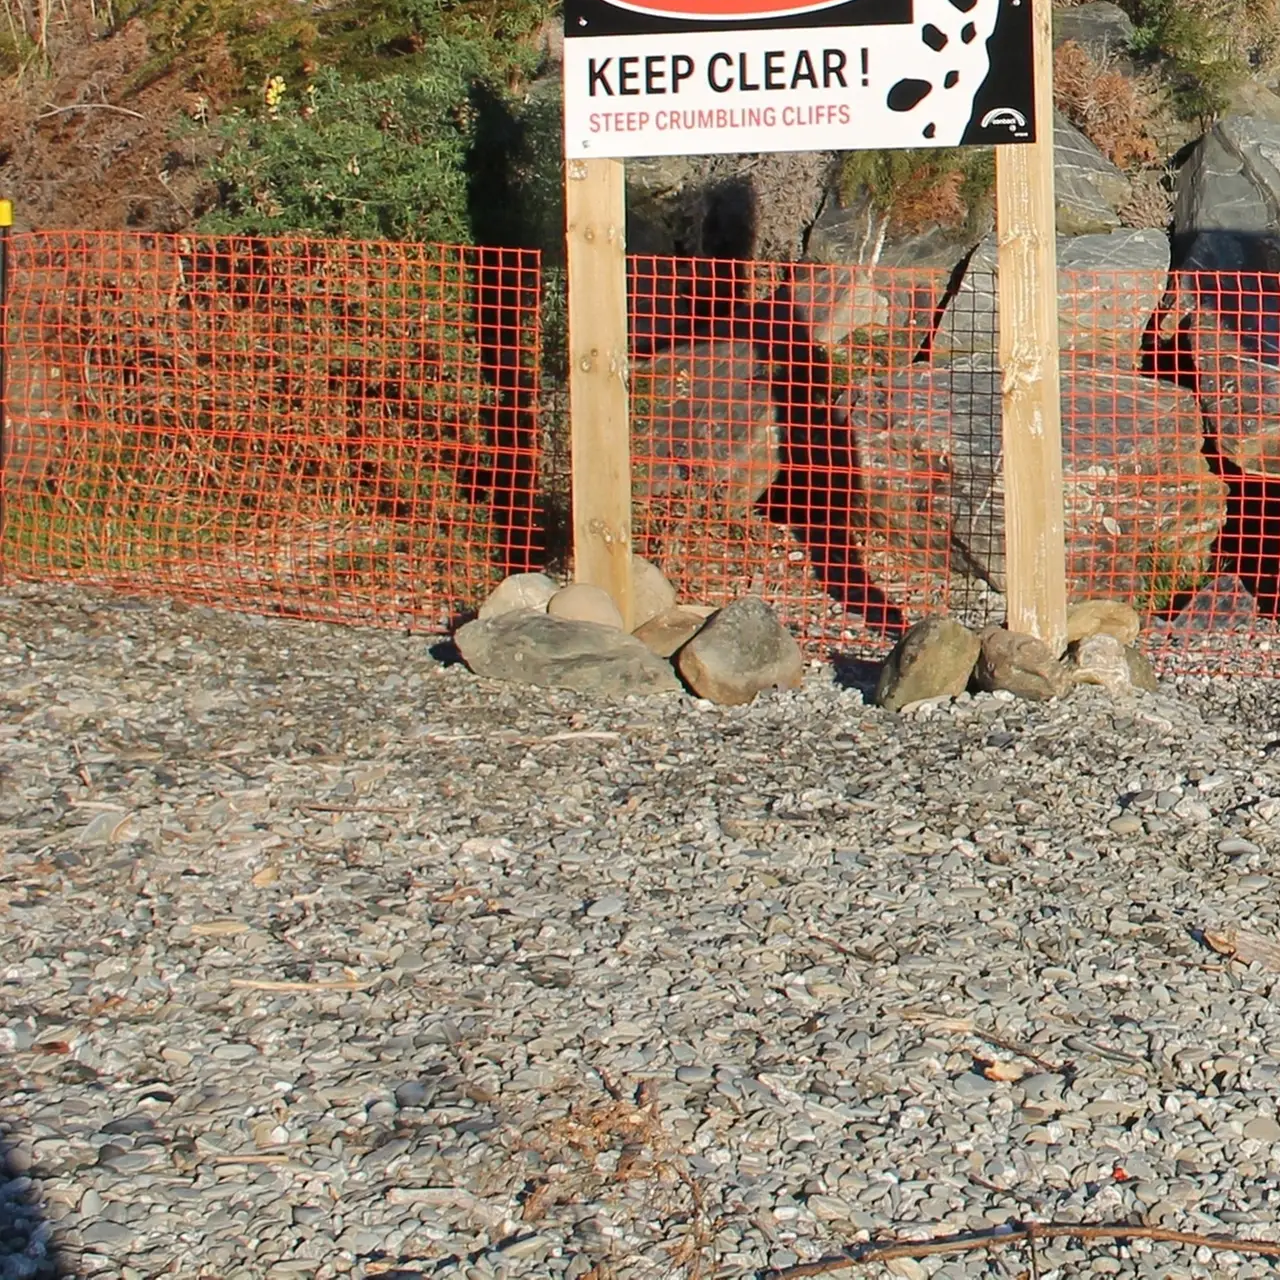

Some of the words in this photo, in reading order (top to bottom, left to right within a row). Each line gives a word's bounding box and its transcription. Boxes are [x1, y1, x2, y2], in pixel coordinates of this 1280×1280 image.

[588, 55, 695, 96] KEEP
[590, 112, 649, 132] STEEP
[656, 107, 776, 130] CRUMBLING
[782, 105, 851, 125] CLIFFS
